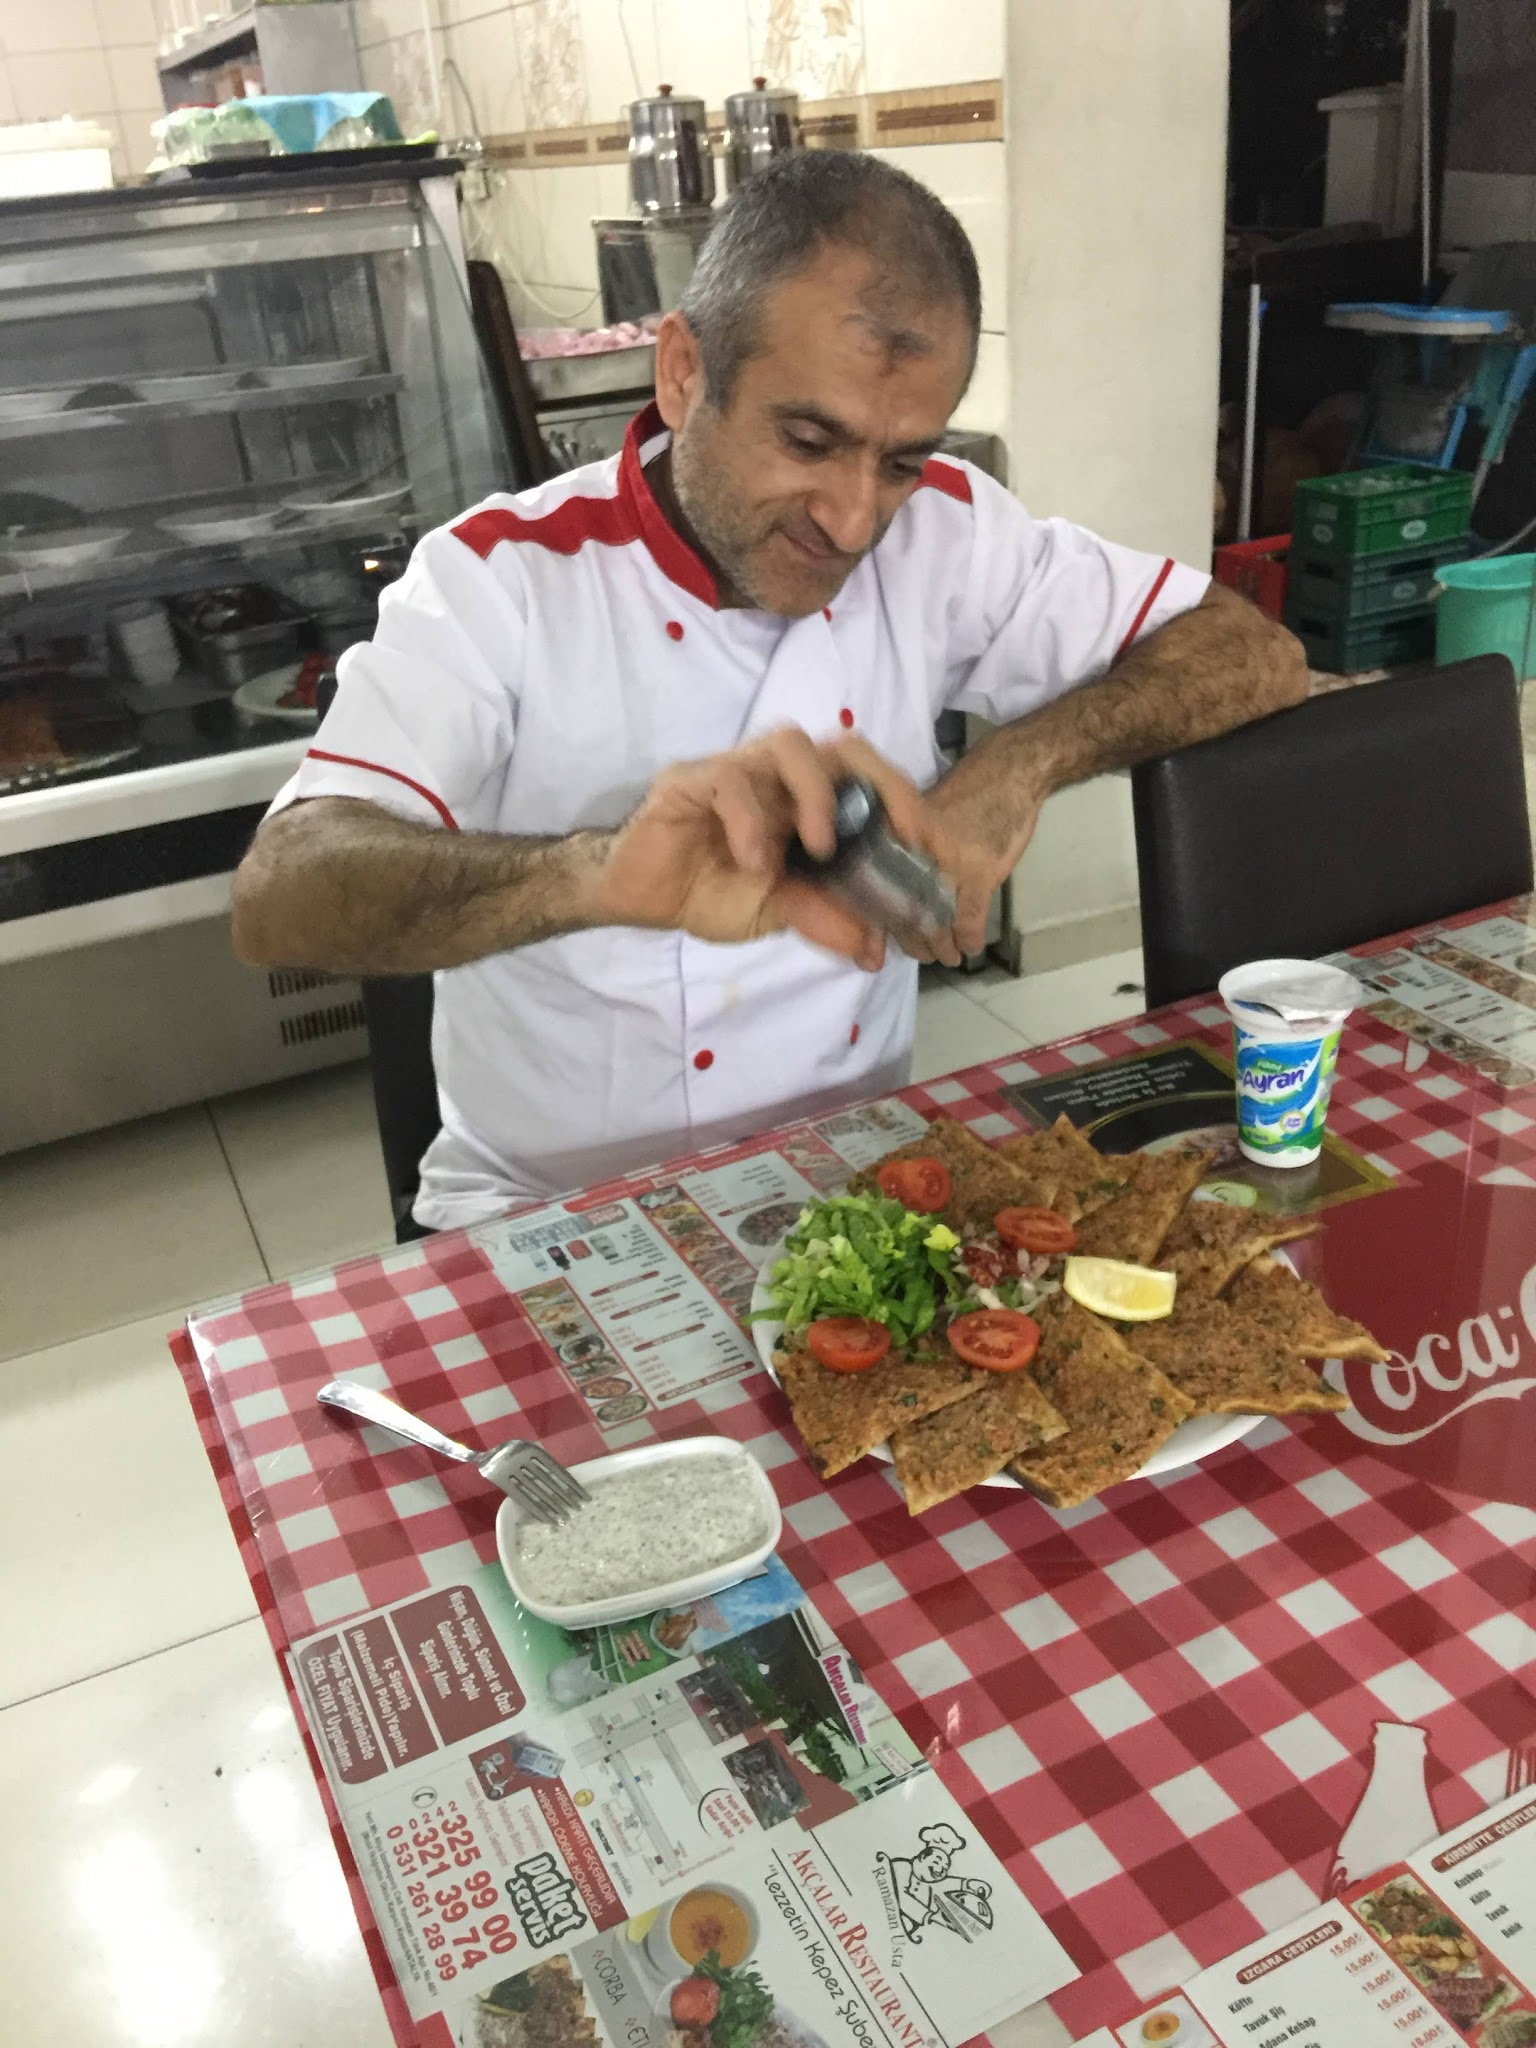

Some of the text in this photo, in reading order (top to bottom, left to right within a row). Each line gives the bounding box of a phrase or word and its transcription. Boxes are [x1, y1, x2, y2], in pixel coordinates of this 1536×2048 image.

[1242, 1068, 1305, 1094] Ayran
[350, 1630, 385, 1692] (Malzemeli
[382, 1655, 411, 1712] İç Sipariş
[419, 1638, 452, 1700] Sipariş Alınır.
[437, 1620, 480, 1702] Günlerinizde Toplu
[474, 1647, 495, 1682] Sünnet
[489, 1680, 503, 1695] ve
[307, 1655, 353, 1772] ÖZEL FİYAT Uygulanır.
[327, 1648, 375, 1761] Toplu Siparişlerinizde
[494, 1691, 516, 1716] Özel
[441, 1814, 518, 1954] 325 99 00
[537, 1792, 604, 1918] KAPIDA ÖDEME KOLAYLIĞI
[568, 1816, 589, 1847] KARTI
[583, 1848, 617, 1905] GEÇERLİDİR
[386, 1825, 458, 1982] 0 531 261 28 99
[412, 1827, 488, 1970] 321 39 74
[507, 1877, 552, 1946] servis
[517, 1853, 585, 1939] paket
[872, 1866, 907, 1969] Ramazan Usta
[1469, 1888, 1493, 1906] Köfte
[1484, 1904, 1510, 1922] Tavuk
[788, 1849, 926, 2048] AKÇALAR RESTAURANT
[1242, 1922, 1338, 1981] IZGARA ÇEŞİTLERİ
[1500, 1921, 1524, 1939] Balık
[803, 1940, 845, 2001] Kepez
[835, 1999, 876, 2048] Şube
[1227, 1995, 1255, 2016] Köfte
[1242, 2013, 1271, 2033] Tavuk
[1269, 2005, 1288, 2021] Şiş
[1286, 2016, 1317, 2037] Kebap
